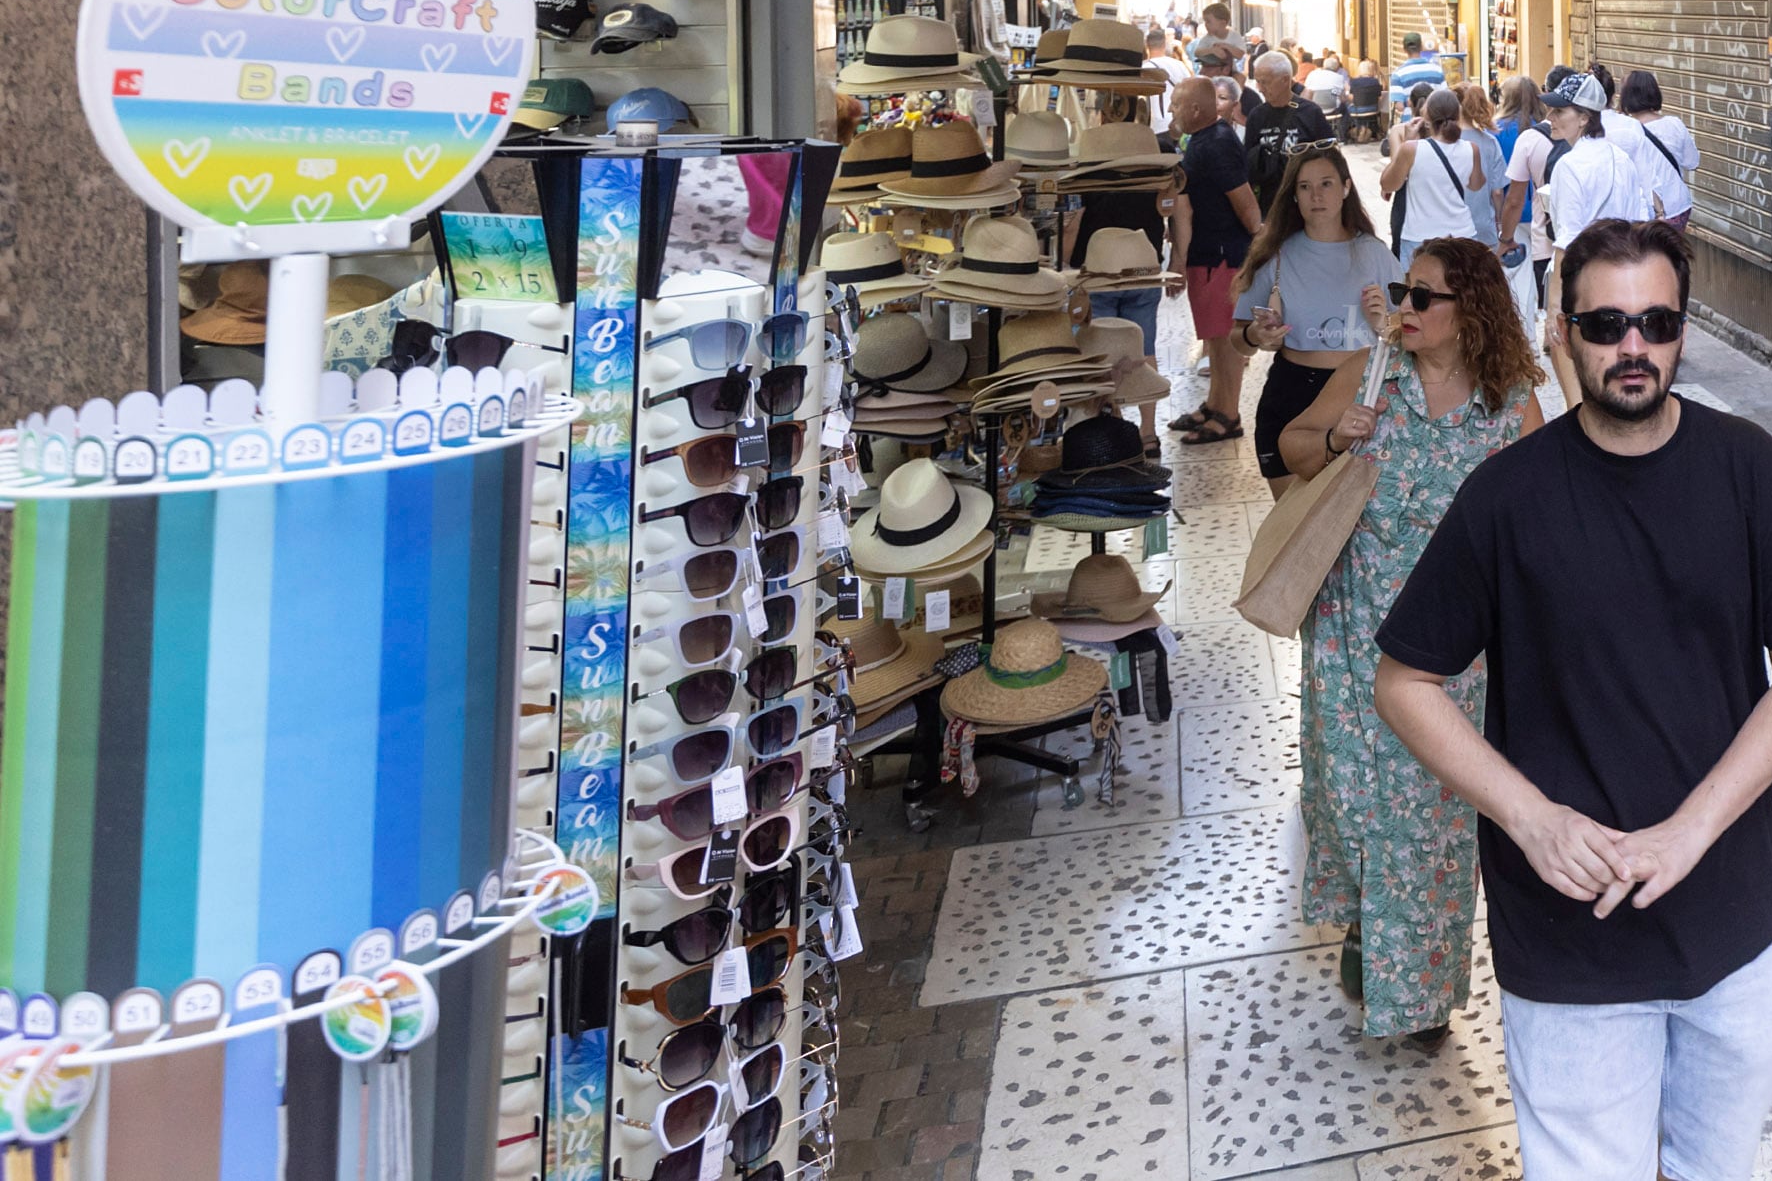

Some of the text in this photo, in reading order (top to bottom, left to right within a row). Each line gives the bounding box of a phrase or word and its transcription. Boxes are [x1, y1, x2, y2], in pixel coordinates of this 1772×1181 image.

[238, 63, 414, 108] Bands
[230, 126, 410, 145] ANKLET & BRACELET
[459, 216, 527, 229] OFERTA
[468, 238, 478, 259] 1
[514, 239, 527, 259] 9
[472, 271, 486, 291] 2
[514, 273, 542, 294] 15
[1306, 327, 1342, 339] Calvin
[447, 416, 466, 433] 26
[484, 408, 499, 427] 27
[351, 432, 375, 449] 24
[402, 423, 425, 441] 25
[234, 444, 262, 461] 22
[293, 438, 320, 456] 23
[177, 450, 201, 465] 21
[453, 902, 470, 923] 57
[410, 922, 432, 942] 56
[360, 943, 385, 963] 55
[305, 965, 331, 984] 54
[245, 978, 274, 998] 53
[185, 993, 213, 1011] 52
[126, 1006, 149, 1021] 51
